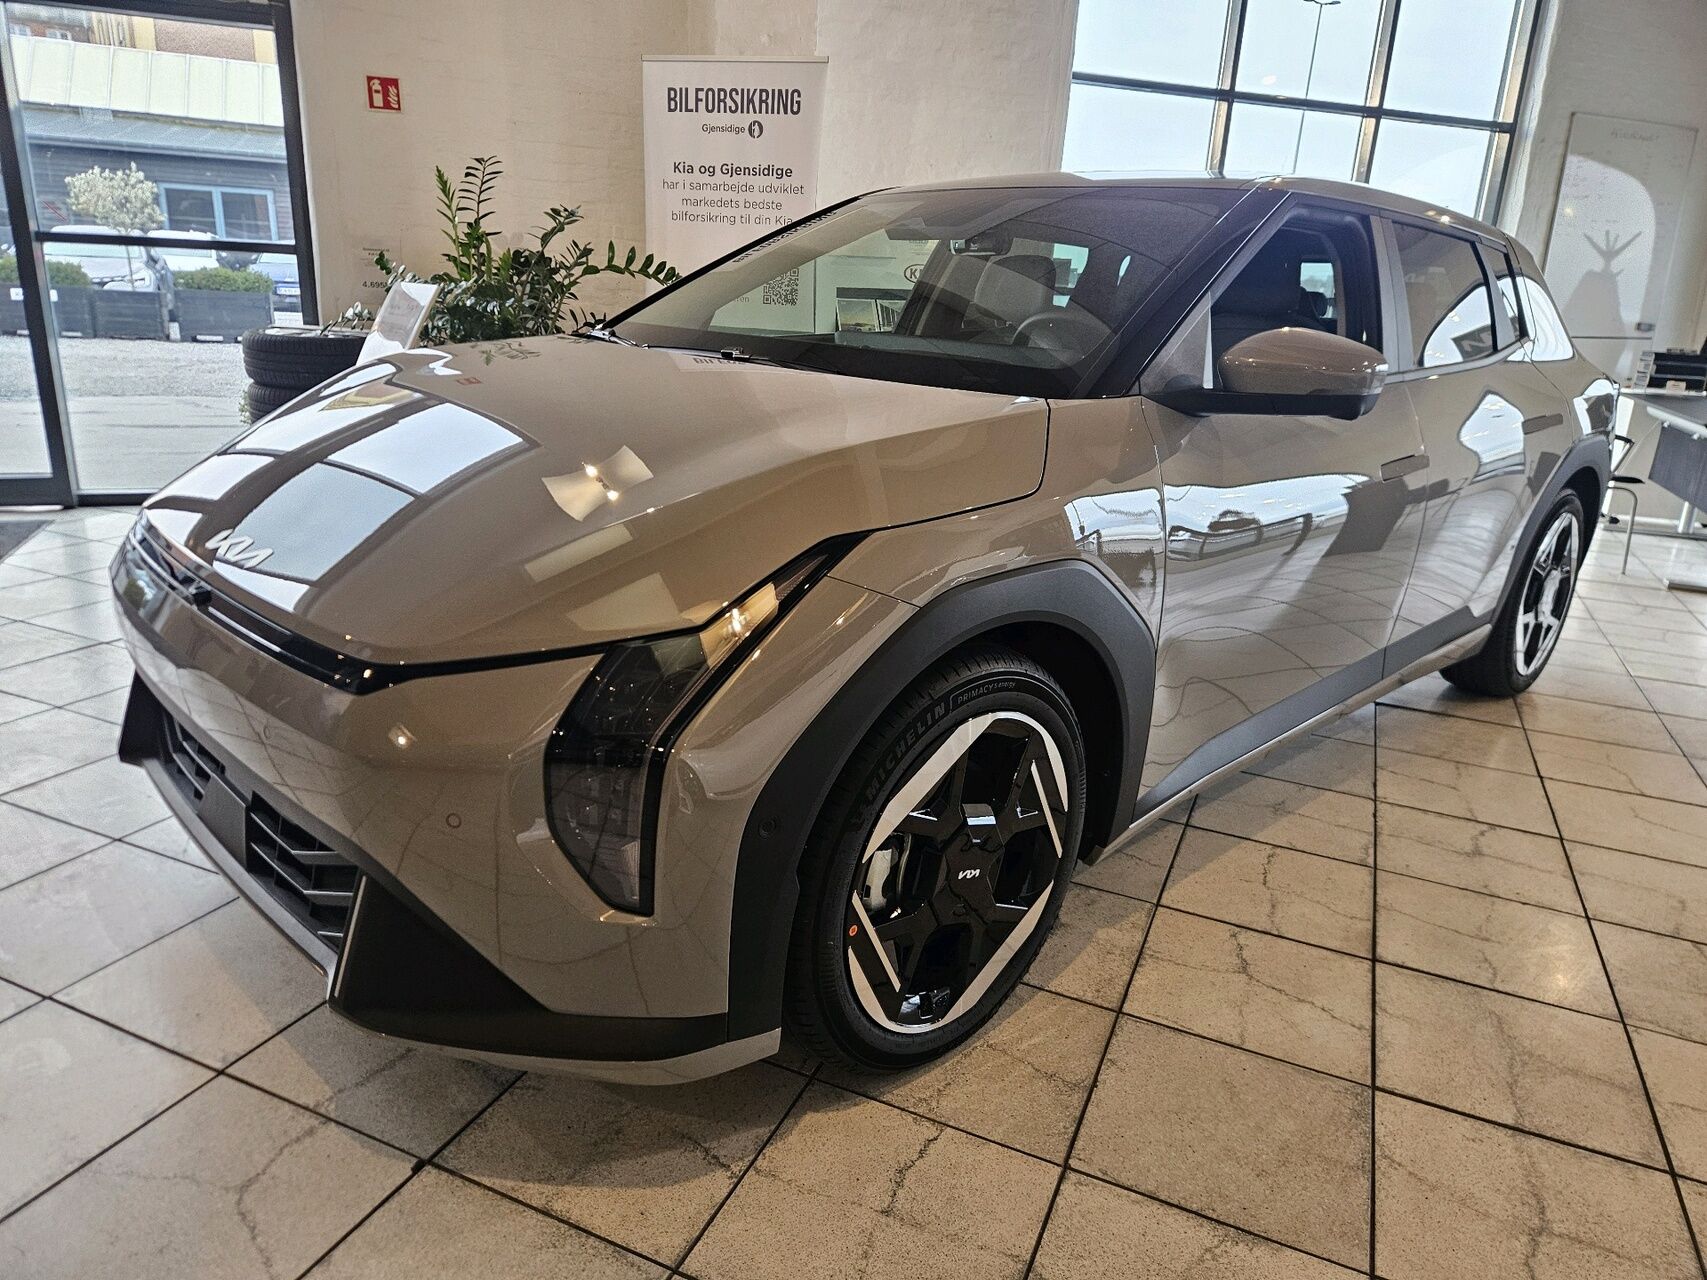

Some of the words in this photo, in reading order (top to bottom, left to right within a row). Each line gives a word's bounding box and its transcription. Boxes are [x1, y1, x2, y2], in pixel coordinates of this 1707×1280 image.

[667, 87, 802, 115] BILFORSIKRING
[701, 124, 746, 134] Gjensidige
[673, 162, 694, 174] Kia
[698, 165, 716, 177] og
[720, 163, 793, 179] Gjensidige
[662, 179, 679, 190] har
[682, 179, 686, 190] i
[689, 181, 755, 194] samarbejde
[758, 183, 805, 195] udviklet
[681, 197, 740, 208] markedets
[743, 198, 783, 210] bedste
[671, 211, 736, 226] bilforsikring
[740, 213, 751, 225] til
[754, 214, 771, 225] din
[866, 702, 945, 798] MICHELIN
[957, 683, 994, 704] PRIMACY
